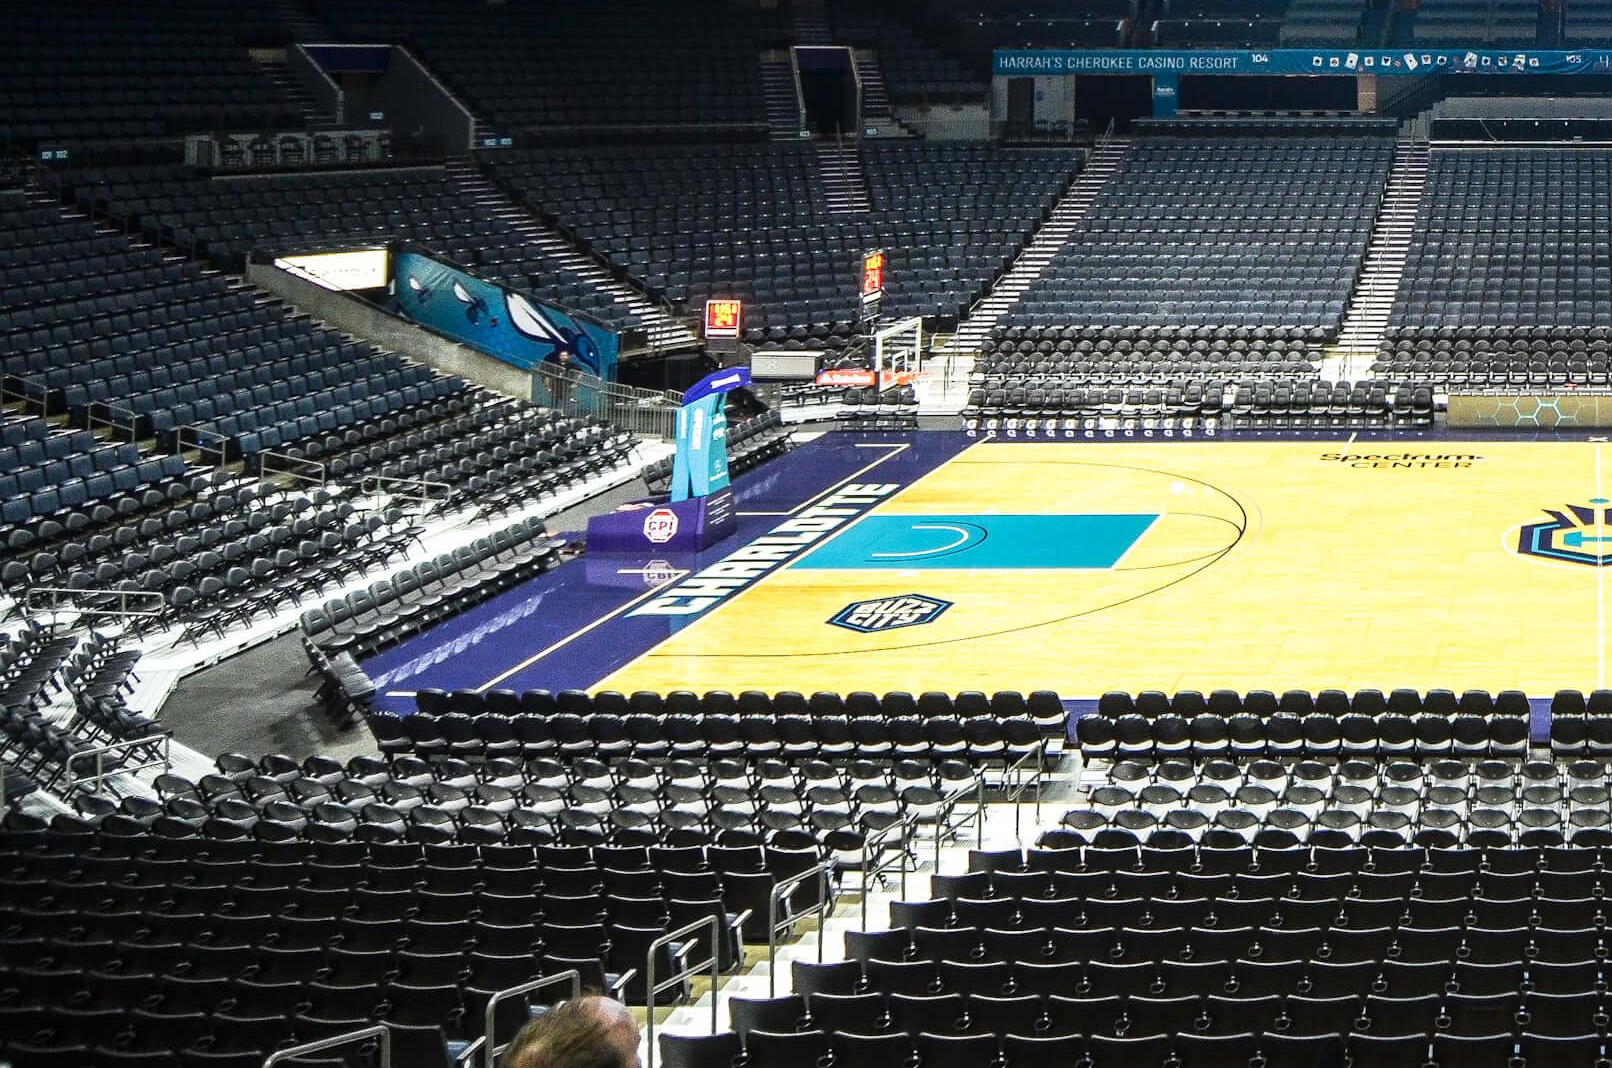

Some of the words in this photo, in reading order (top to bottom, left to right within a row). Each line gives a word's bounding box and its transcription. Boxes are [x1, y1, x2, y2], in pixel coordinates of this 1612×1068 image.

[999, 56, 1062, 69] HARRAH'S
[1067, 56, 1134, 69] CHEROKEE
[1138, 56, 1185, 69] CASINO
[1189, 56, 1238, 69] RESORT
[1252, 53, 1269, 64] 104
[1320, 453, 1475, 463] Spectrum
[648, 521, 674, 532] CPI
[624, 483, 901, 618] CHARLOTTE
[853, 597, 939, 613] BUZZ
[844, 613, 921, 629] CITY
